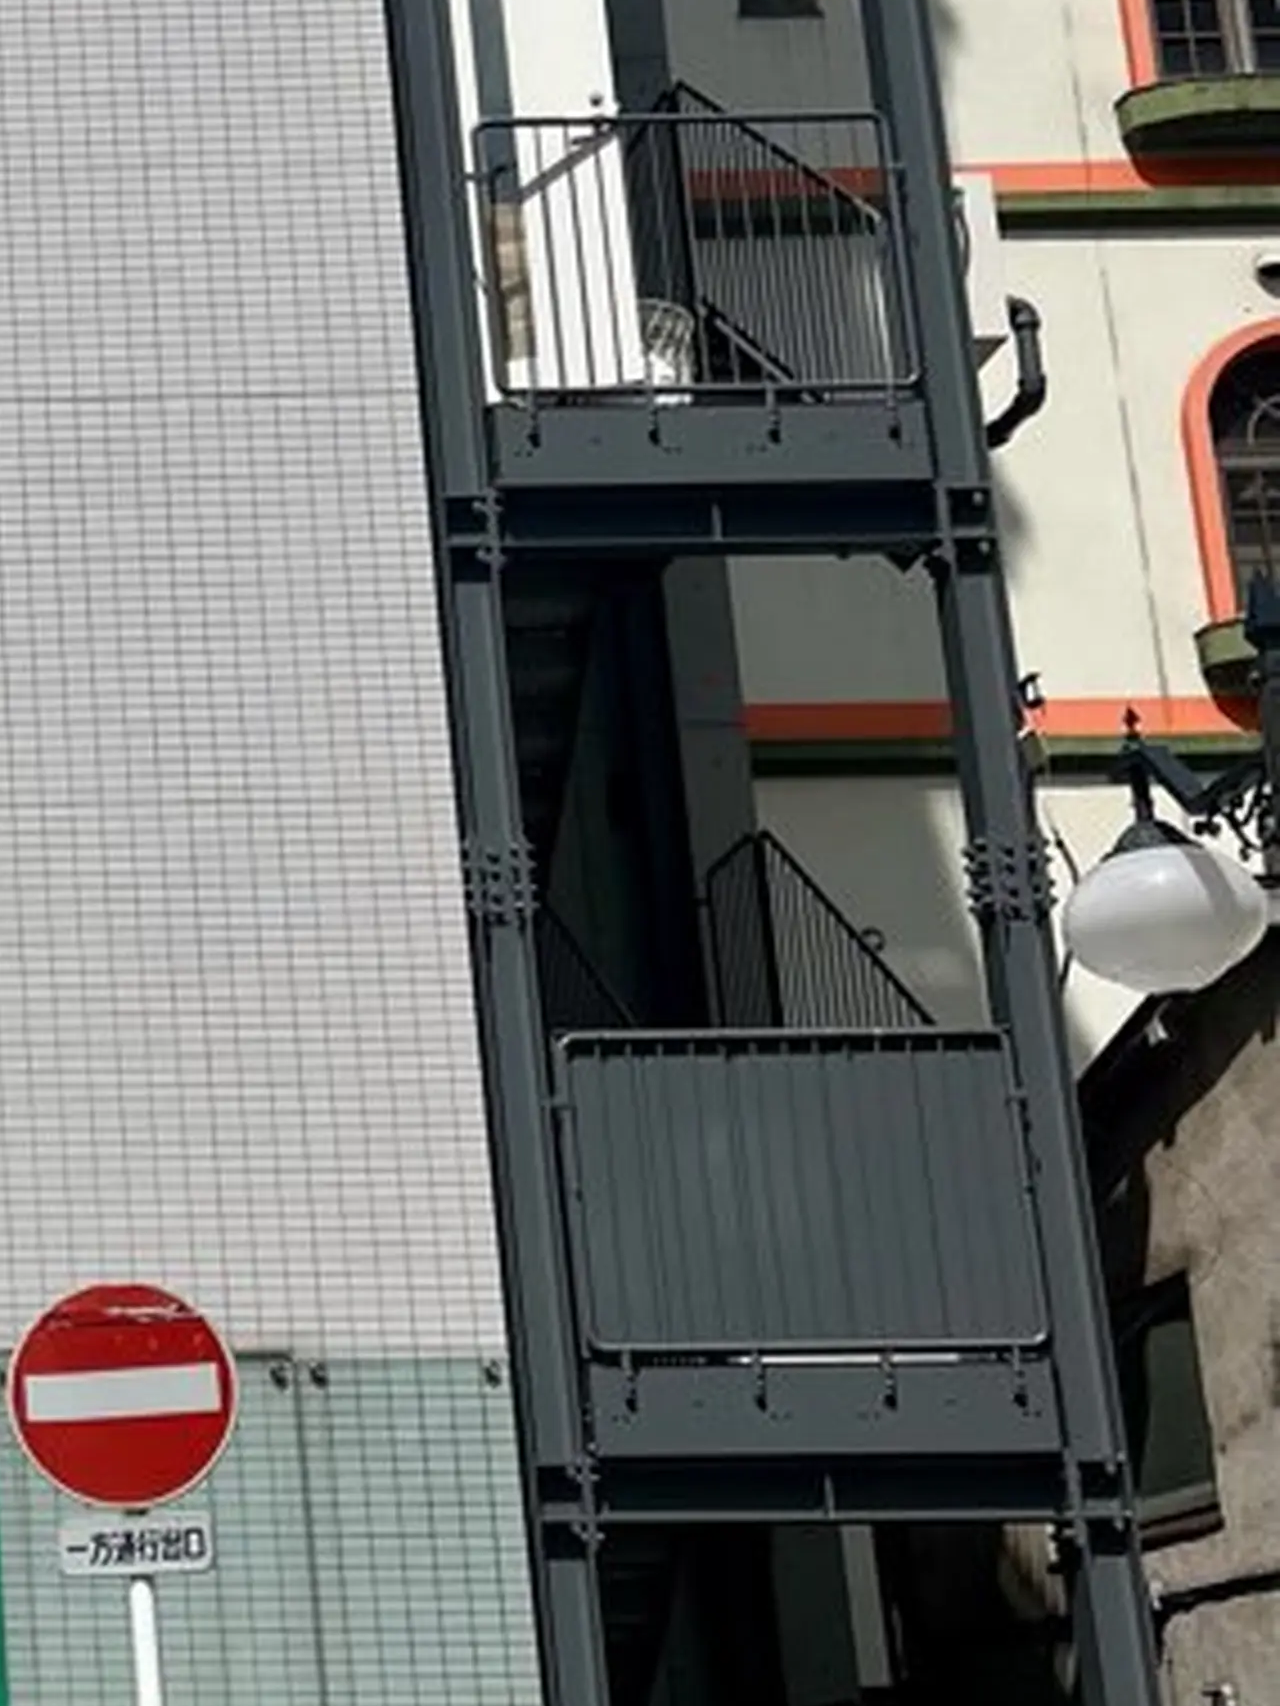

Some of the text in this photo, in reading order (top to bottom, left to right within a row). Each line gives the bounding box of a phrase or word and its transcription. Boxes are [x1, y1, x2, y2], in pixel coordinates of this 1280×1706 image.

[66, 1528, 206, 1566] 一方通行出口
